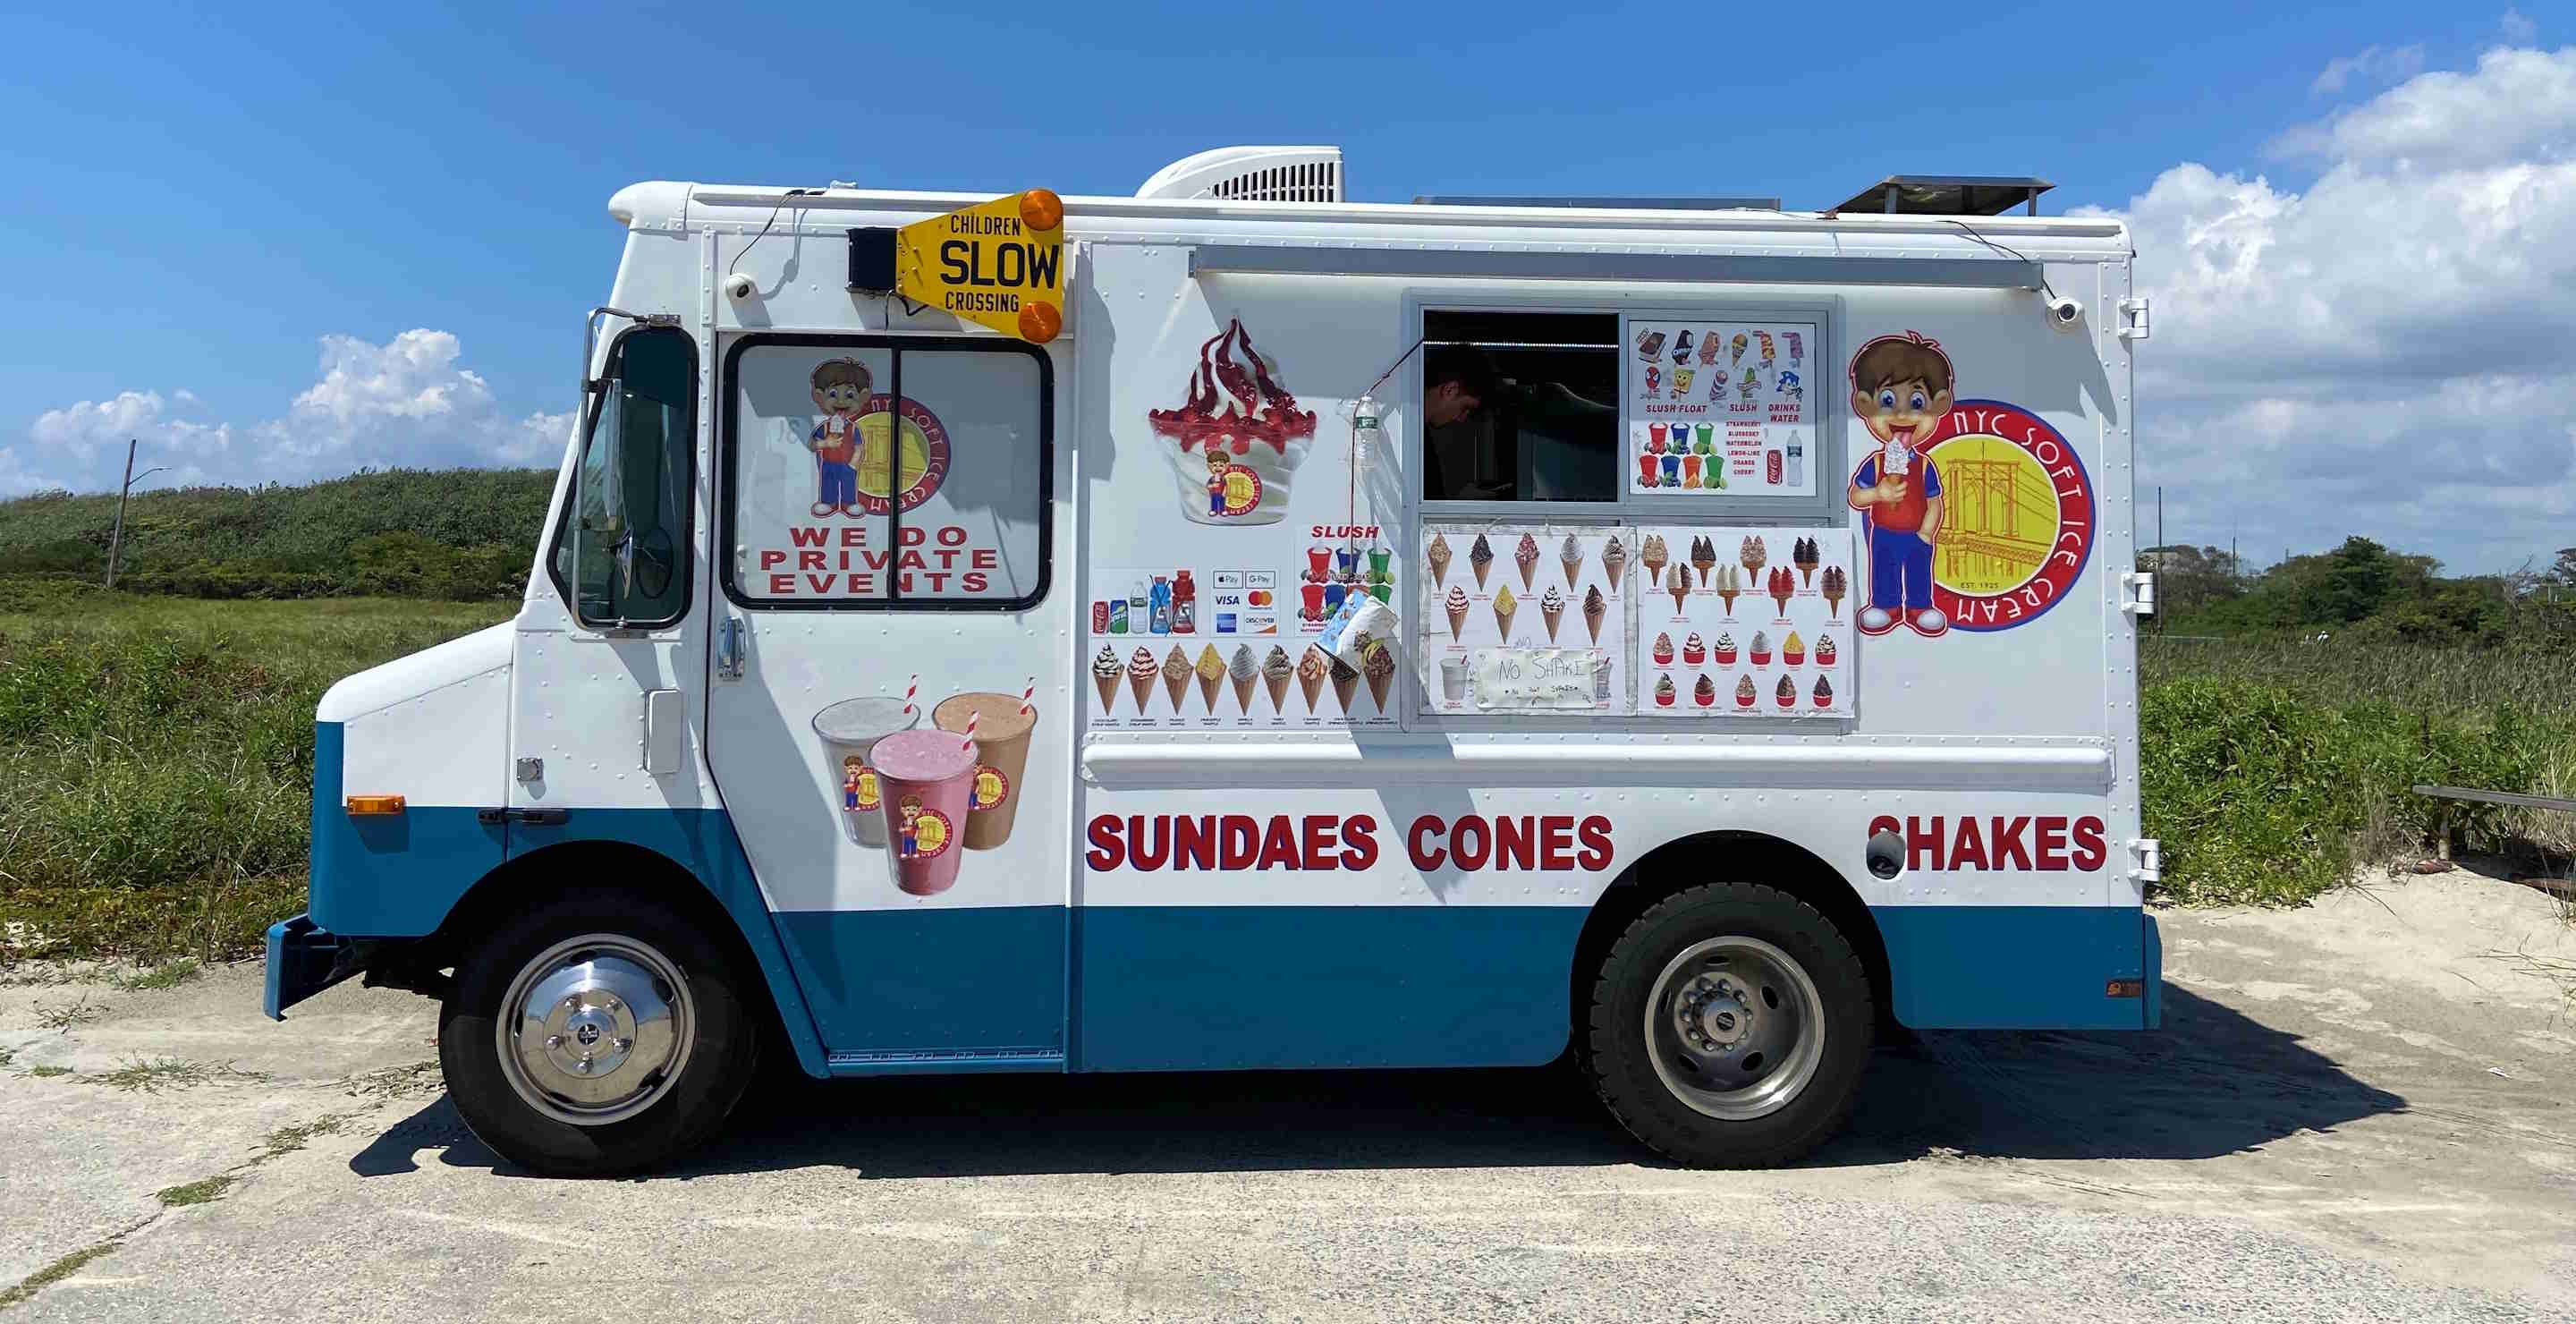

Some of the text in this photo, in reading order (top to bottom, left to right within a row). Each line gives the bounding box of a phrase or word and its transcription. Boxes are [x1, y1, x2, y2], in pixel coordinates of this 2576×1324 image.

[951, 215, 1021, 236] CHILDREN
[940, 240, 1059, 289] SLOW
[945, 292, 1020, 312] CROSSING
[1646, 404, 1707, 413] SLUSH FLOAT
[1729, 403, 1758, 412] SLUSH
[1768, 403, 1801, 412] DRINKS
[909, 408, 944, 446] SOFT
[1770, 414, 1800, 423] WATER
[926, 456, 945, 480] ICE
[1953, 411, 2085, 623] NYC SOFT ICE CREAM
[790, 526, 968, 547] WE DO
[1311, 526, 1380, 539] SLUSH
[760, 549, 997, 571] PRIVATE
[1216, 596, 1240, 605] VISA
[1085, 814, 1378, 872] SUNDAES
[1407, 815, 1614, 872] CONES
